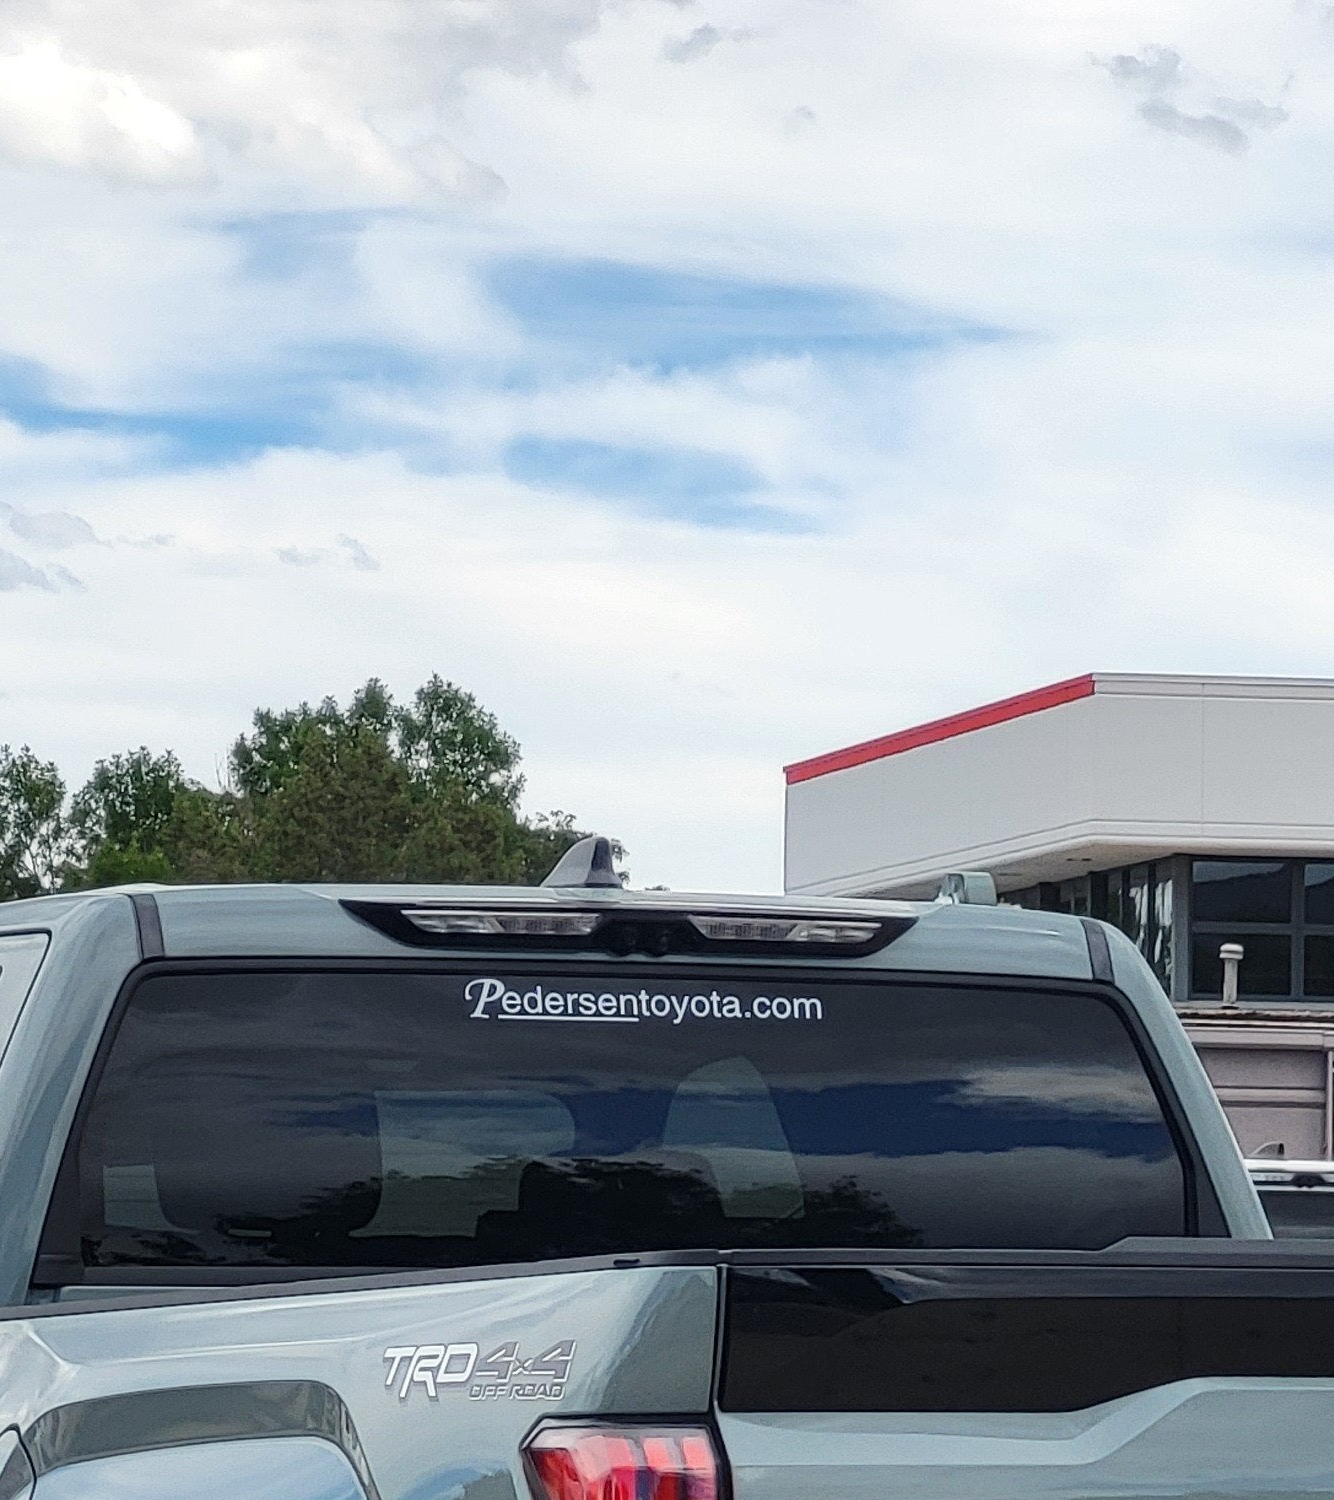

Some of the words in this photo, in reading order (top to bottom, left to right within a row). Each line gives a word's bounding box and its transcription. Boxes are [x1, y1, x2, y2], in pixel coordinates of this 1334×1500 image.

[464, 977, 822, 1024] Pedersentoyota.com
[383, 1342, 478, 1399] TRD
[469, 1382, 507, 1401] OFF
[509, 1382, 566, 1401] ROAD
